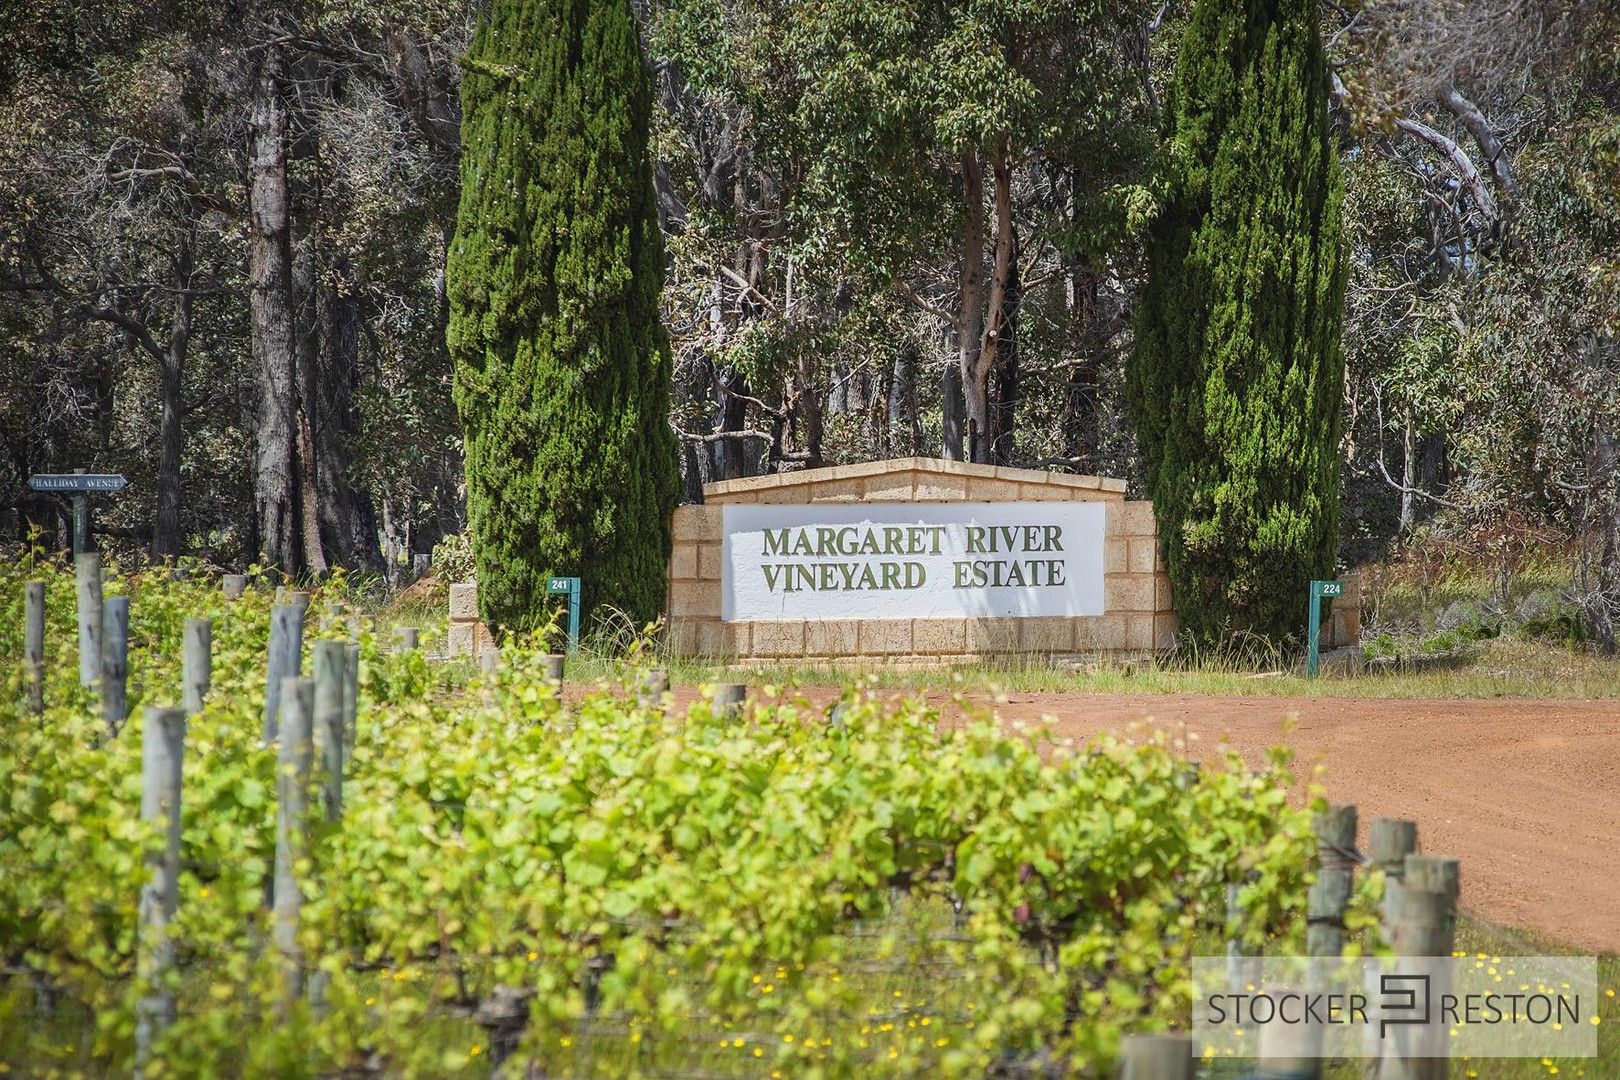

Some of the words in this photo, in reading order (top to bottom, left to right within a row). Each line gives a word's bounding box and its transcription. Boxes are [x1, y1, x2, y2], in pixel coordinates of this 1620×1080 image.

[35, 479, 79, 488] HALLIDAY
[85, 479, 119, 488] AVENUE
[761, 526, 947, 557] MARGARET
[965, 524, 1065, 553] RIVER
[760, 560, 927, 593] VINEYARD
[952, 559, 1066, 590] ESTATE
[551, 580, 567, 590] 241
[1323, 584, 1341, 594] 224
